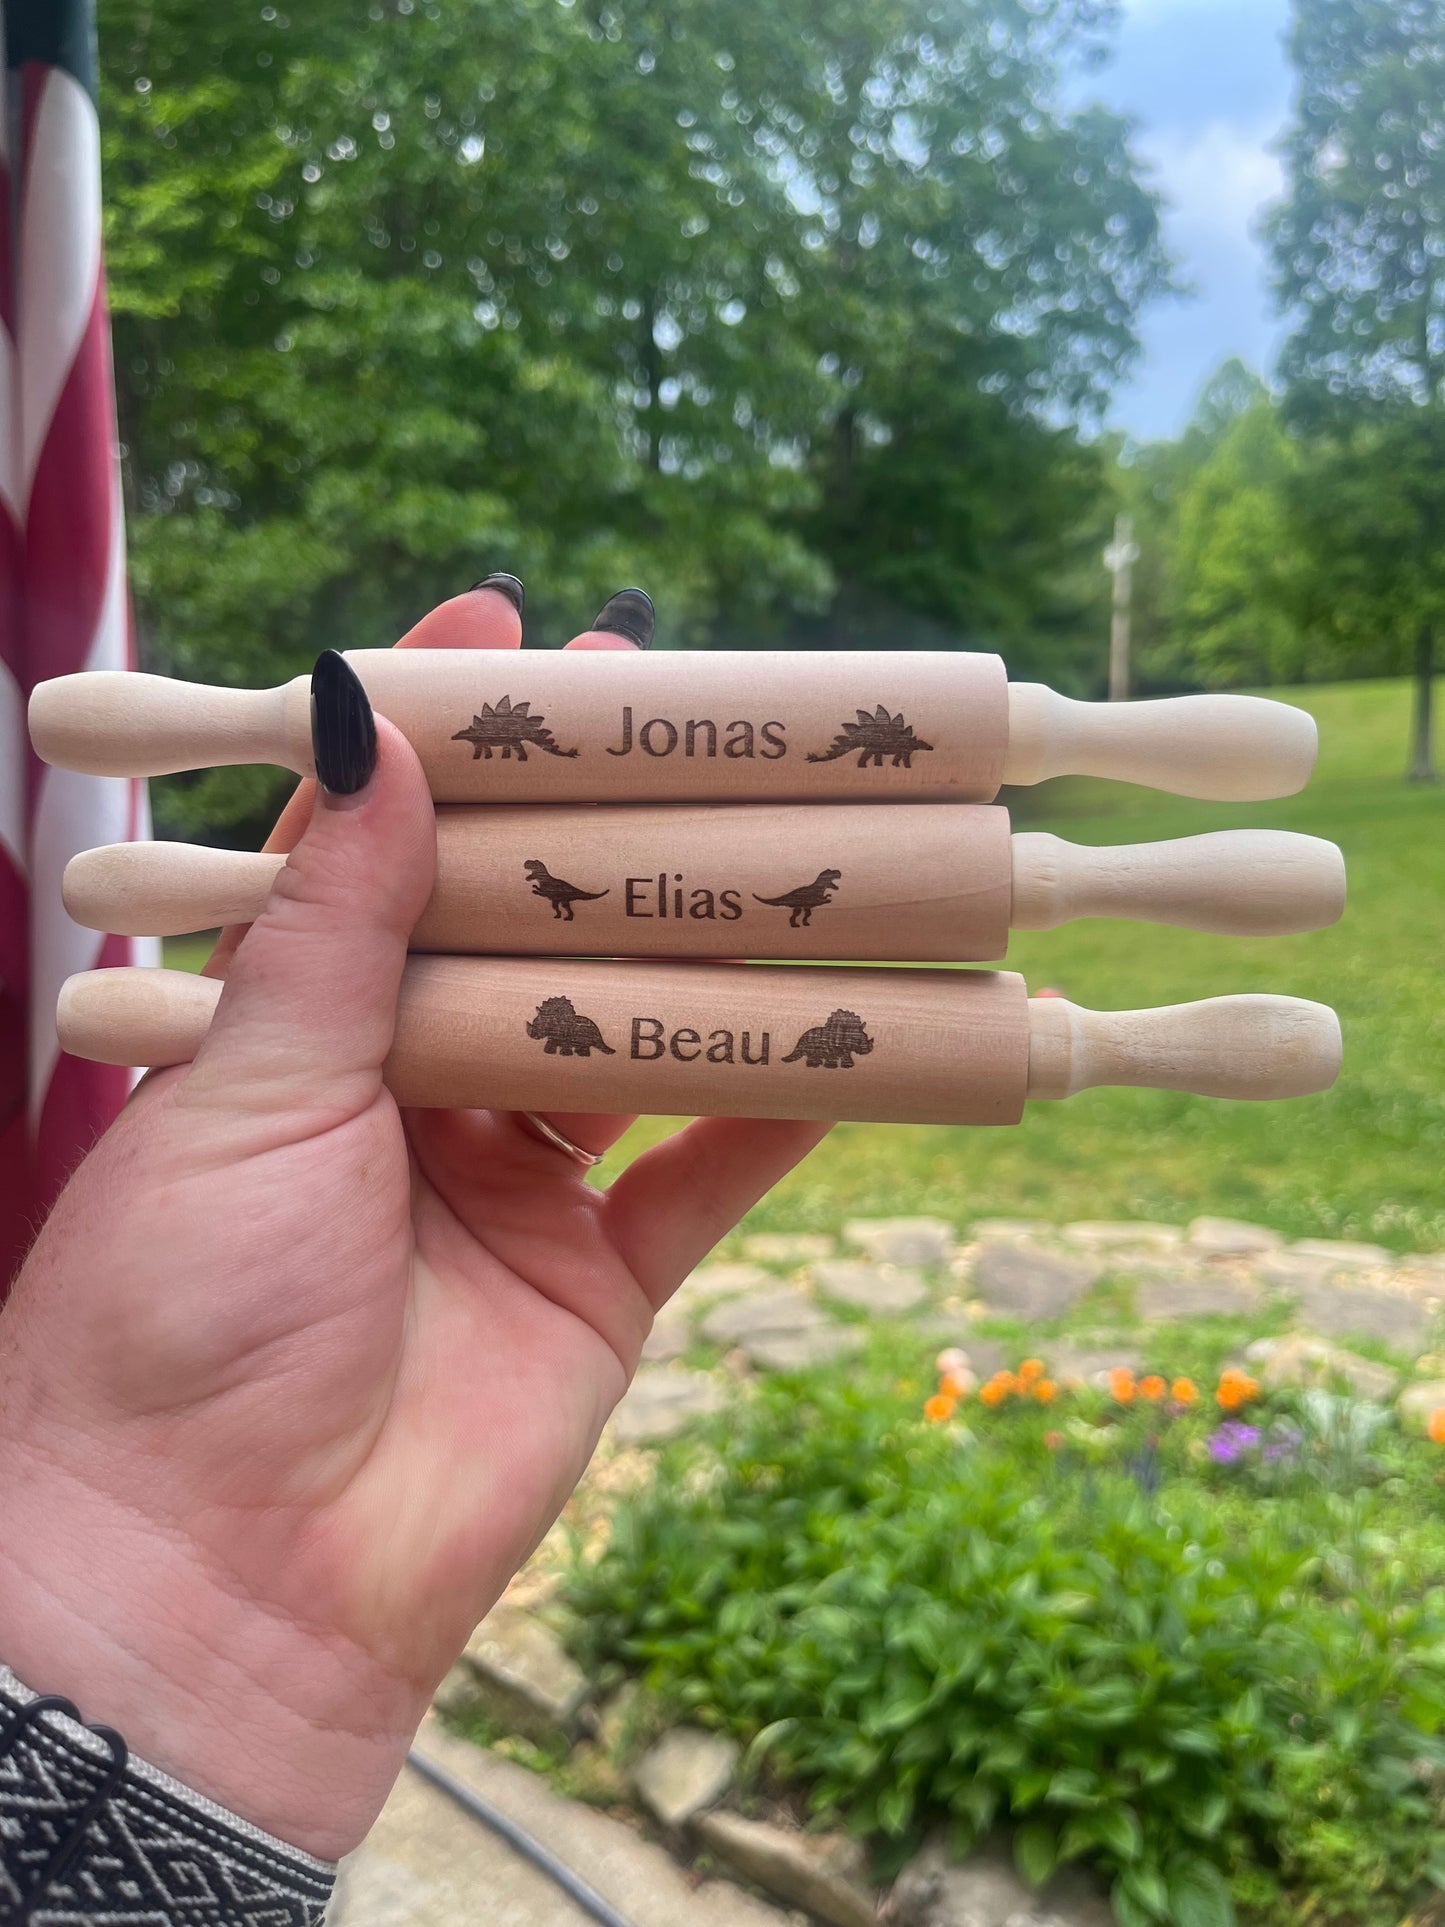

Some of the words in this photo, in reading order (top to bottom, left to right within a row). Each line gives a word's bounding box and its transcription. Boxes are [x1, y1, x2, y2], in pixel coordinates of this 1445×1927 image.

[605, 706, 787, 760] Jonas
[625, 872, 743, 921] Elias
[630, 1017, 770, 1066] Beau
